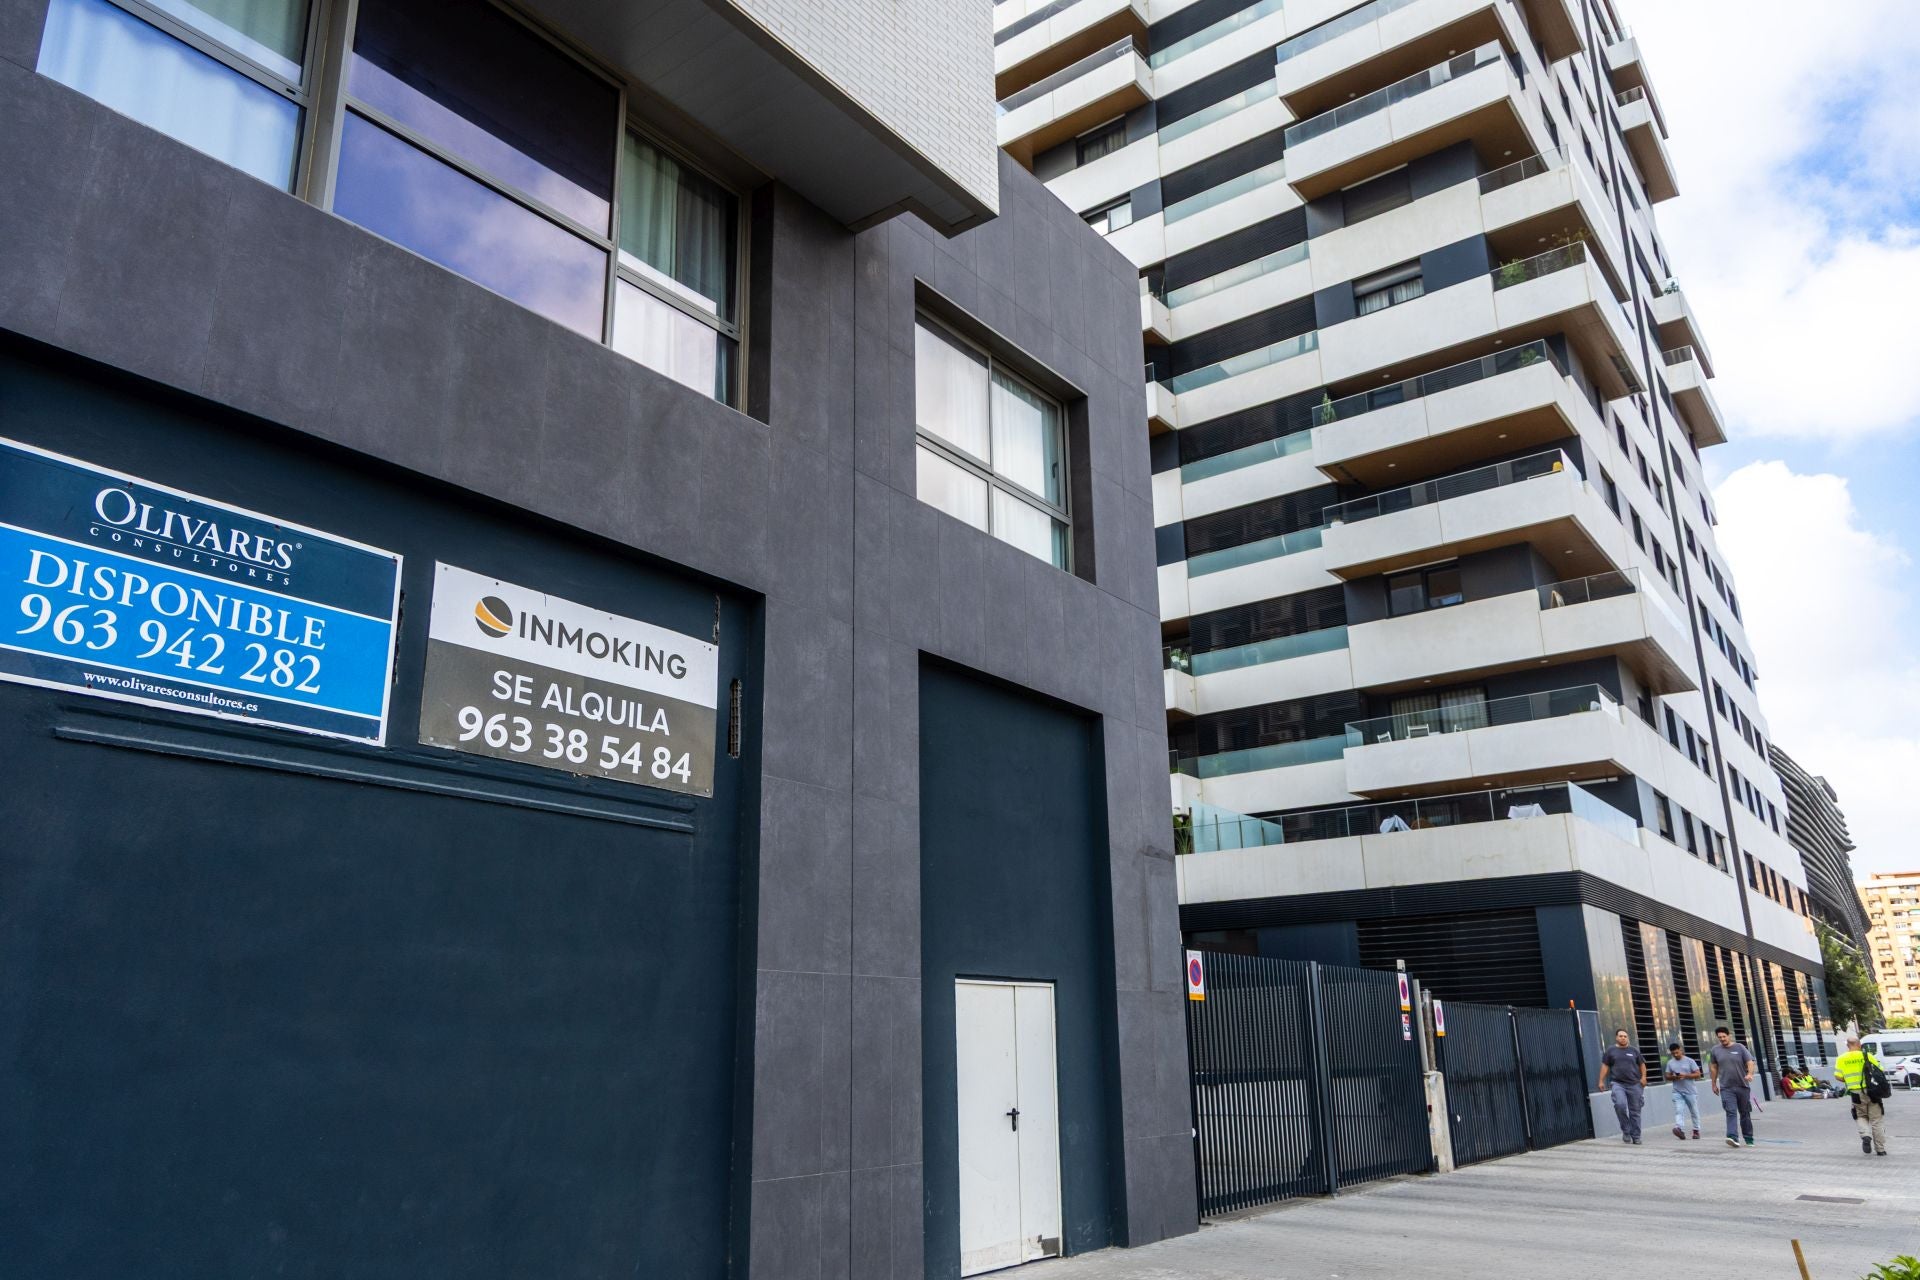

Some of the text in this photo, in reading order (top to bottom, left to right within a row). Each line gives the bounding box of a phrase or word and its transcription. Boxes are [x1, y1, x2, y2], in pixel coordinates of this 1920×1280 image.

[89, 527, 290, 586] CONSULTORES
[23, 549, 326, 650] DISPONIBLE
[16, 593, 321, 694] 963 942 282
[519, 611, 688, 680] INMOKING
[83, 671, 259, 712] www.olivaresconsultores.es
[491, 670, 670, 736] SE ALQUILA
[457, 705, 692, 784] 963 38 54 84
